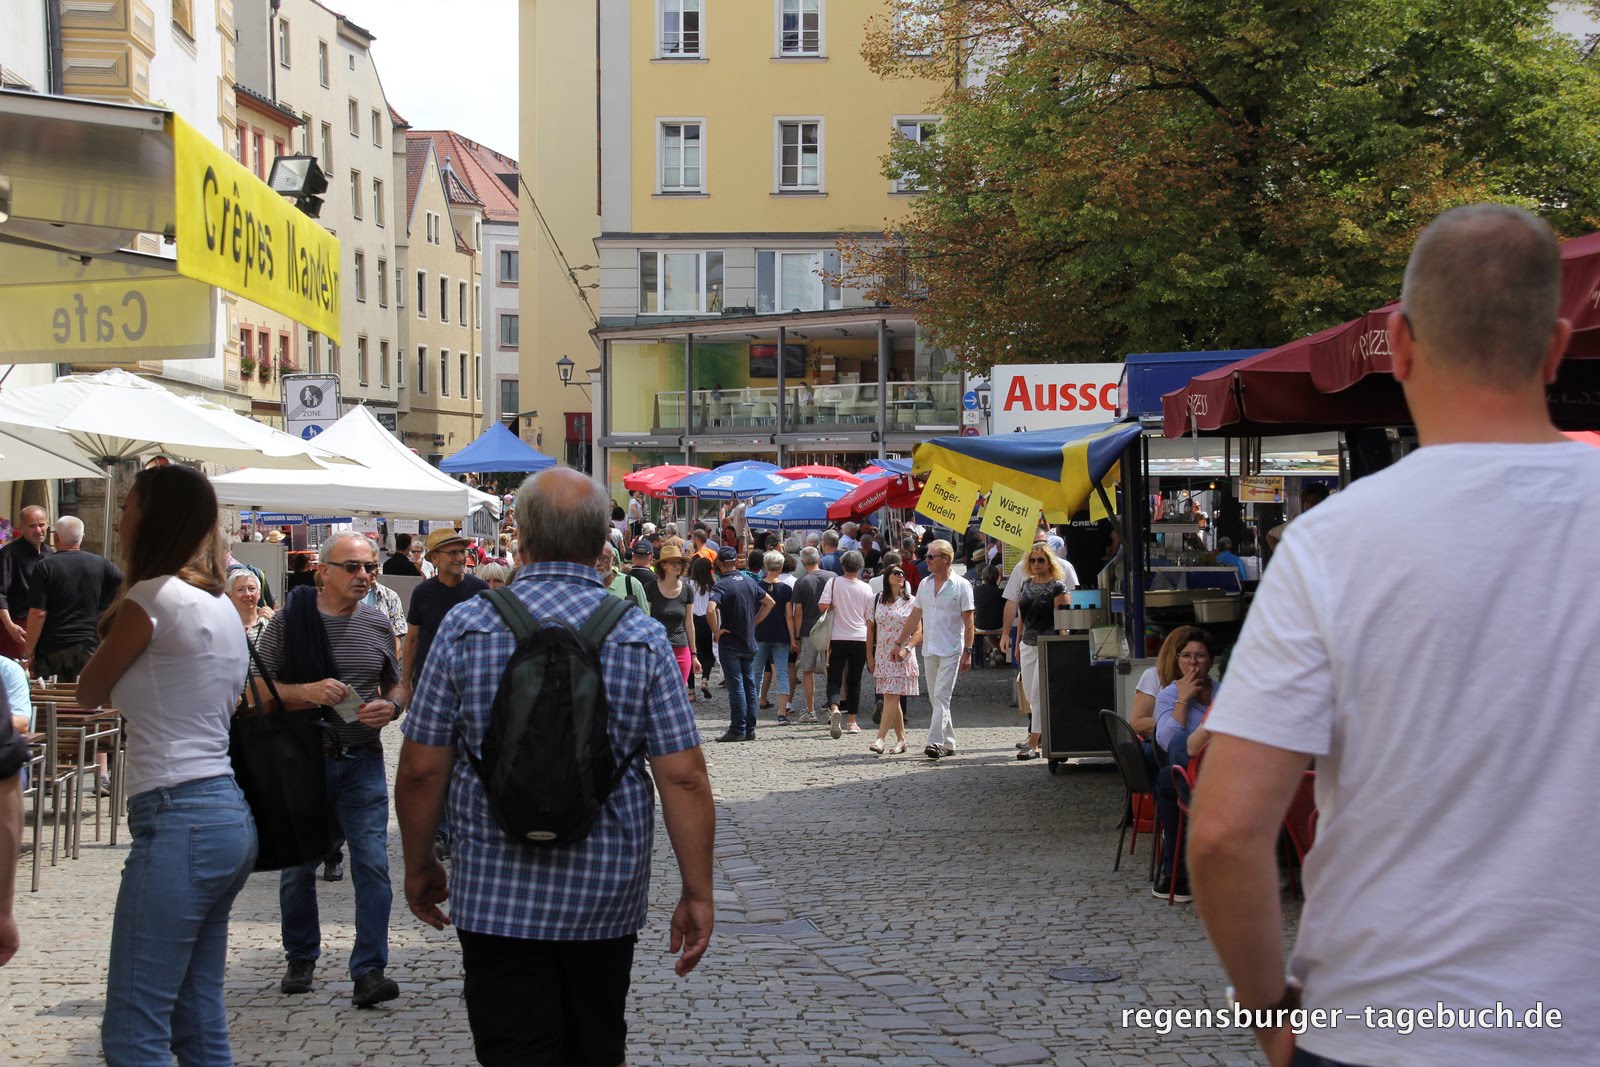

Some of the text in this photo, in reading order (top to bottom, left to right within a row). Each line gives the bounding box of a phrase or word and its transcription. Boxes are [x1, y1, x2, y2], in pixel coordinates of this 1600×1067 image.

[203, 165, 338, 313] Crêpes Mandeln
[932, 484, 961, 503] Finger-
[926, 500, 956, 521] nudeln
[1000, 496, 1029, 518] Würstl
[993, 515, 1023, 537] Steak
